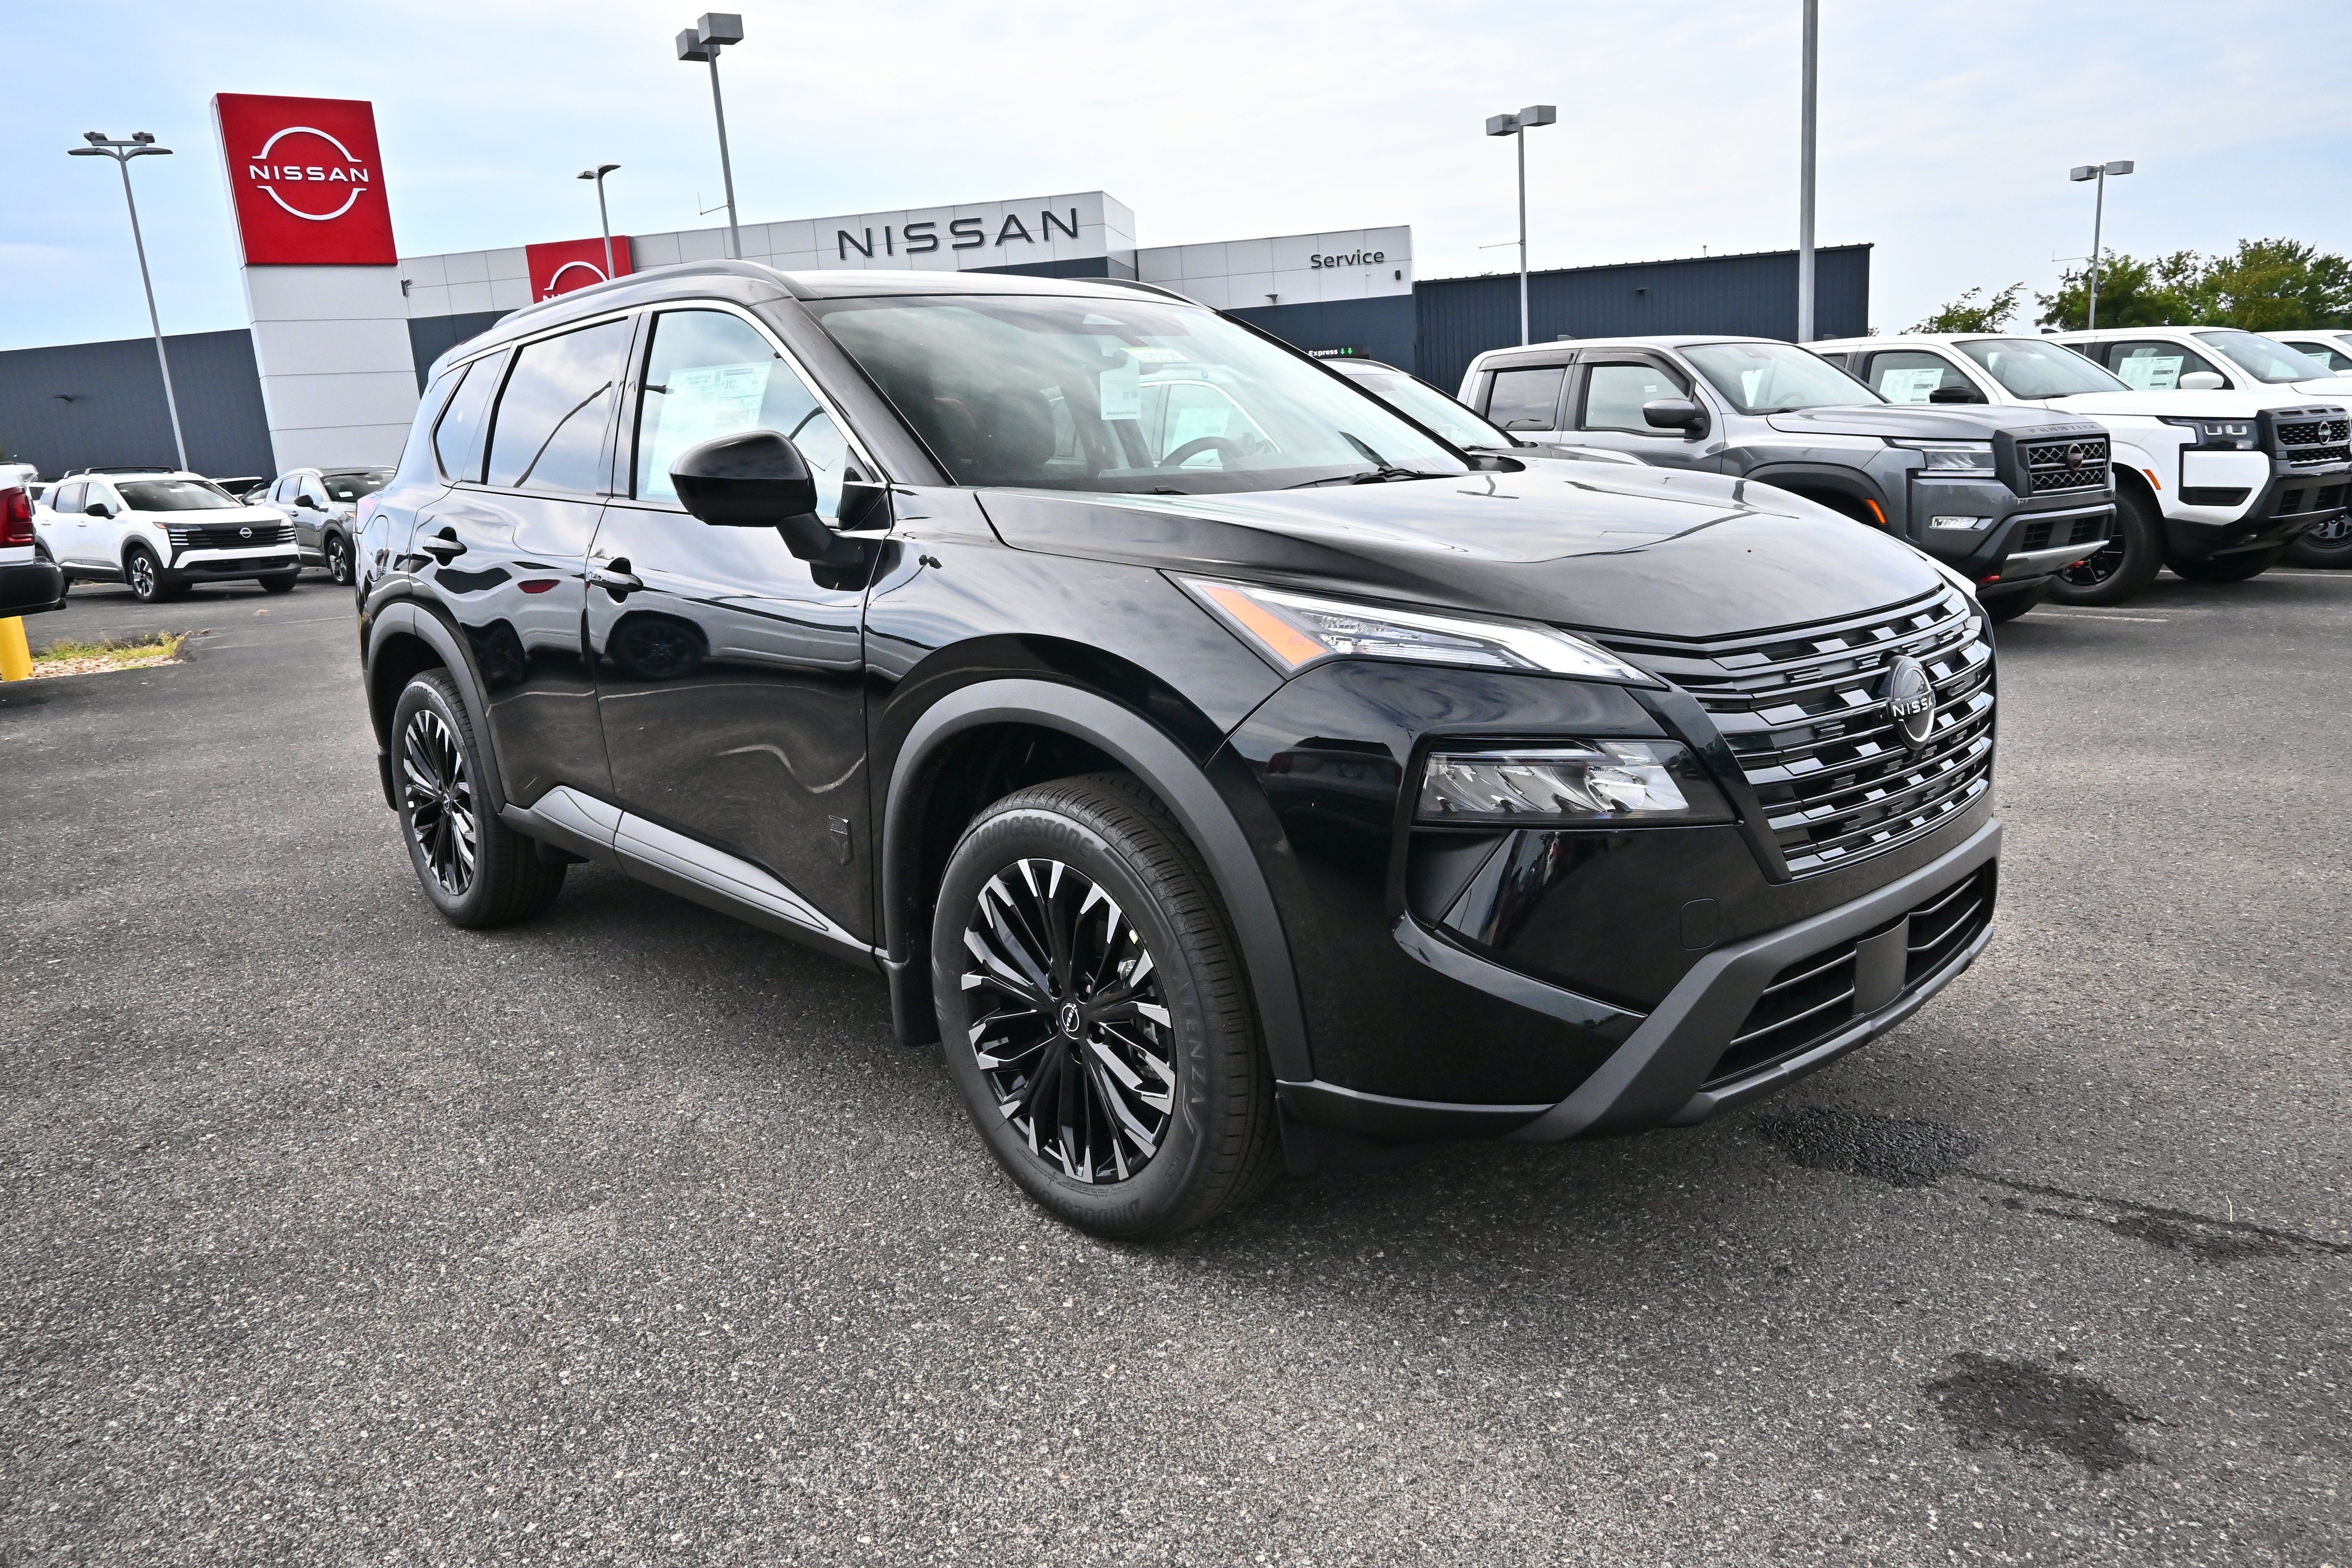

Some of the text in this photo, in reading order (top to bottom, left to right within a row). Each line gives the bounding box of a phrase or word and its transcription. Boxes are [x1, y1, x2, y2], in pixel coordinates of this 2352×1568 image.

[249, 165, 369, 182] NISSAN
[837, 207, 1079, 260] NISSAN
[1310, 249, 1385, 269] Service
[1308, 349, 1338, 357] Express
[2027, 425, 2097, 433] FRONTIER
[1892, 696, 1933, 717] NISSA
[969, 816, 1094, 860] BRIDGESTONE
[1065, 1003, 1077, 1033] NISSAN
